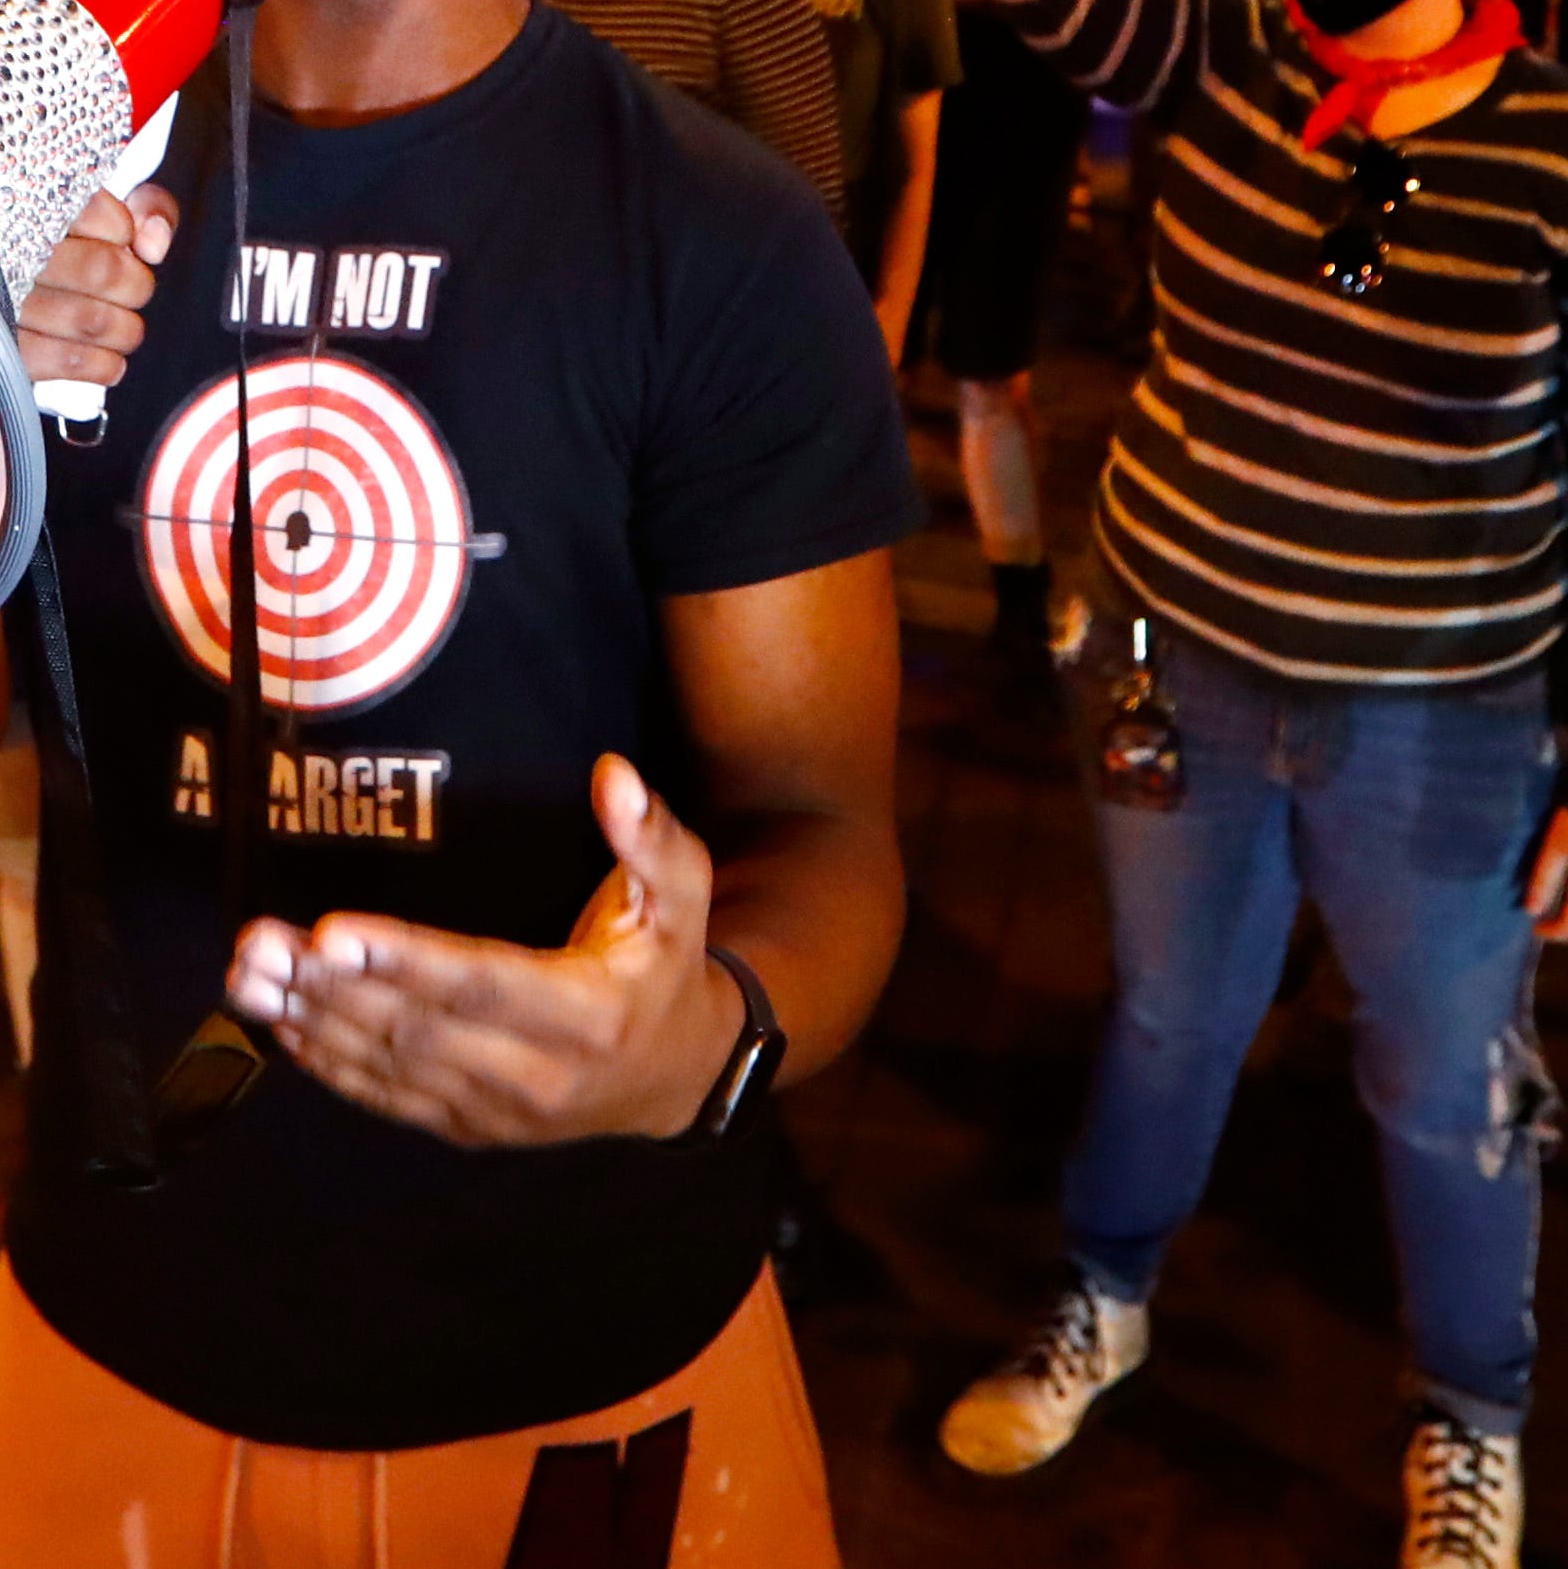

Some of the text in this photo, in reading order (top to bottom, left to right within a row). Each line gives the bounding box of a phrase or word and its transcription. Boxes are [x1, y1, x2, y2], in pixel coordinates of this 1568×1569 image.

[230, 245, 443, 330] I'M NOT
[174, 734, 443, 842] A ARGET
